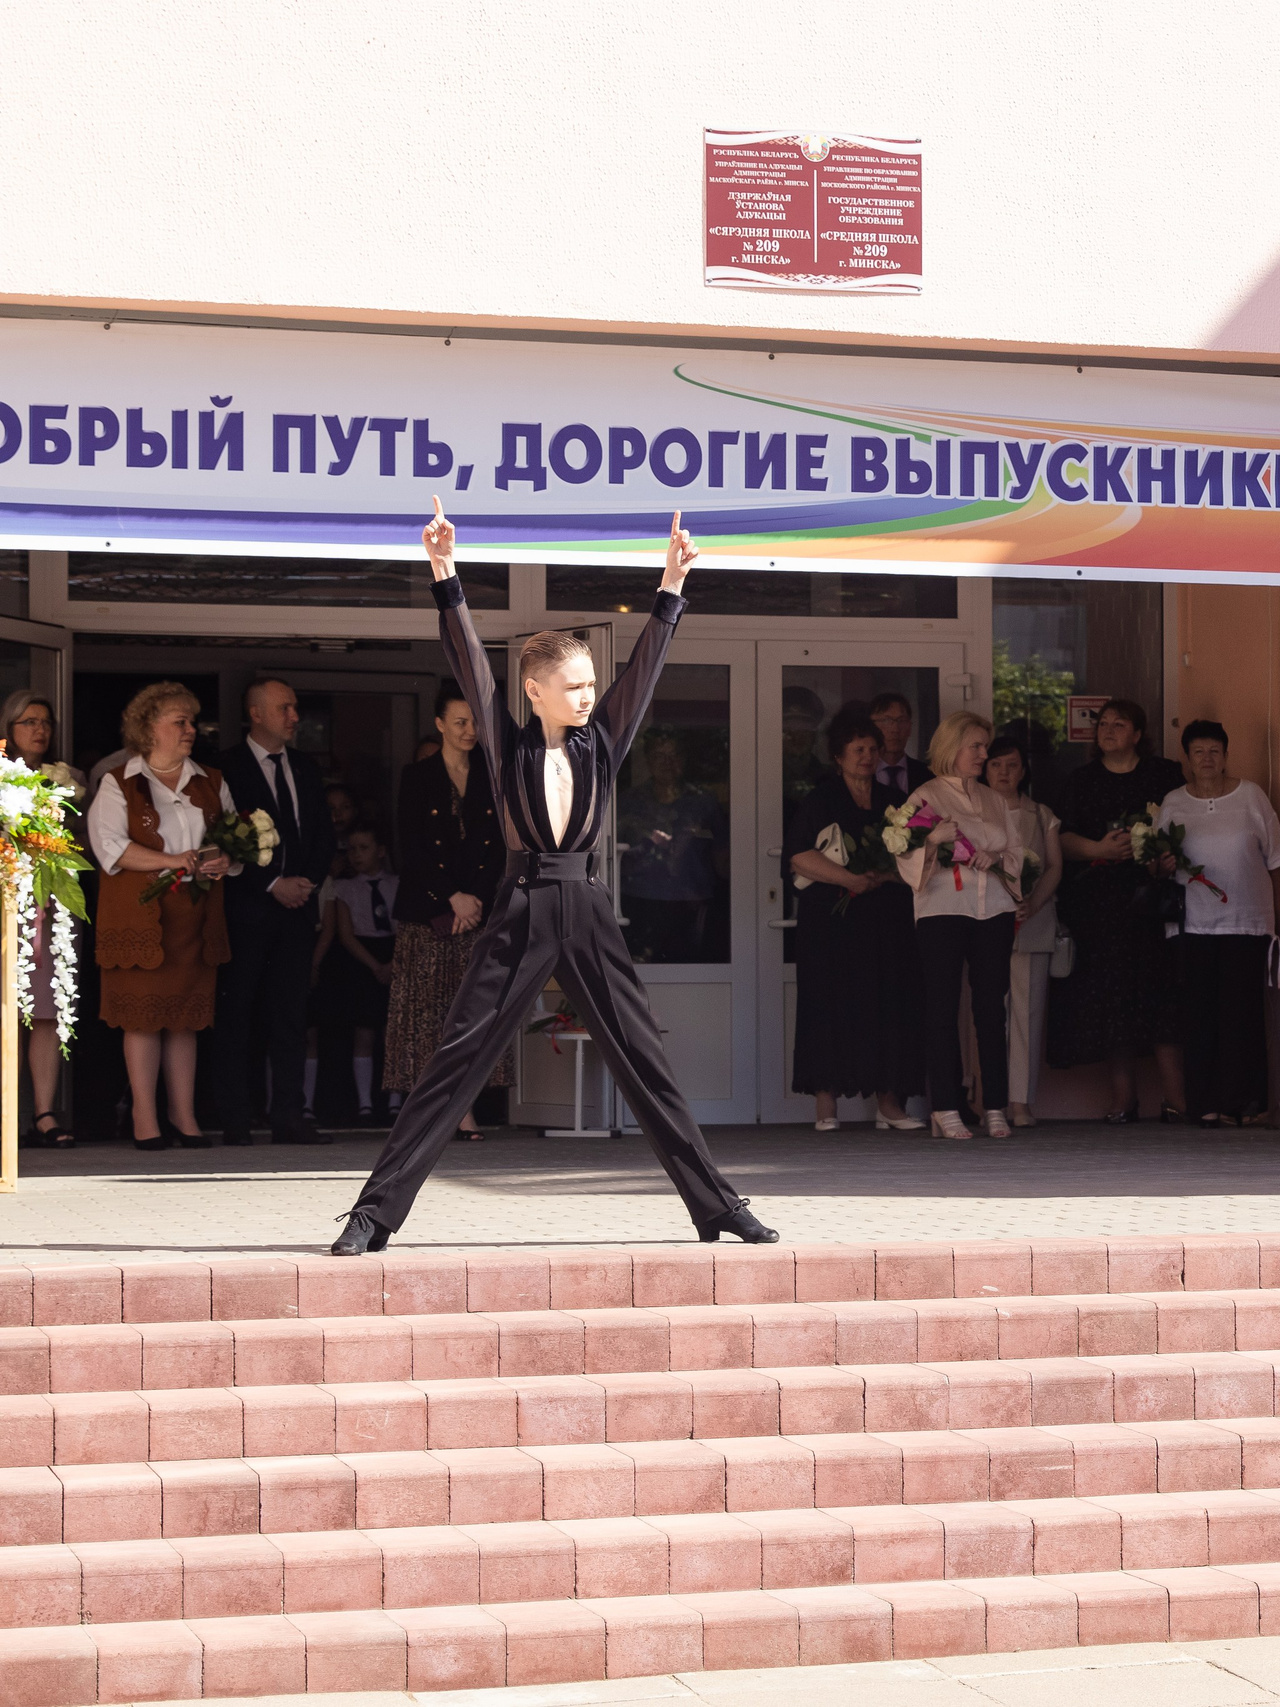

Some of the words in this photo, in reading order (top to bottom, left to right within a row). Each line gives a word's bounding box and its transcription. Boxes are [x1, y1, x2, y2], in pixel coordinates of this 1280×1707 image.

[713, 149, 759, 157] РЭСПУБЛІКА
[832, 155, 880, 163] РЕСПУБЛИКА
[881, 157, 918, 165] БЕЛАРУСЬ
[844, 175, 898, 183] АДМИНИСТРАЦИИ
[821, 182, 865, 190] МОСКОВСКОГО
[866, 183, 890, 191] РАЙОНА
[727, 192, 791, 202] ДЗЯРЖАЎНАЯ
[828, 196, 915, 208] ГОСУДАРСТВЕННОЕ
[736, 211, 786, 221] АДУКАЦЫІ
[840, 206, 902, 216] УЧРЕЖДЕНИЕ
[838, 216, 904, 226] ОБРАЗОВАНИЯ
[709, 226, 770, 238] «СЯРЭДНЯЯ
[772, 228, 811, 240] ШКОЛА
[820, 231, 877, 242] «СРЕДНЯЯ
[878, 233, 919, 244] ШКОЛА
[743, 242, 754, 251] №
[756, 239, 780, 252] 209
[853, 246, 864, 256] №
[864, 244, 888, 257] 209
[741, 254, 791, 264] МІНСКА»
[849, 258, 901, 269] МИНСКА»
[272, 412, 474, 491] ПУТЬ,
[494, 422, 829, 492] ДОРОГИЕ
